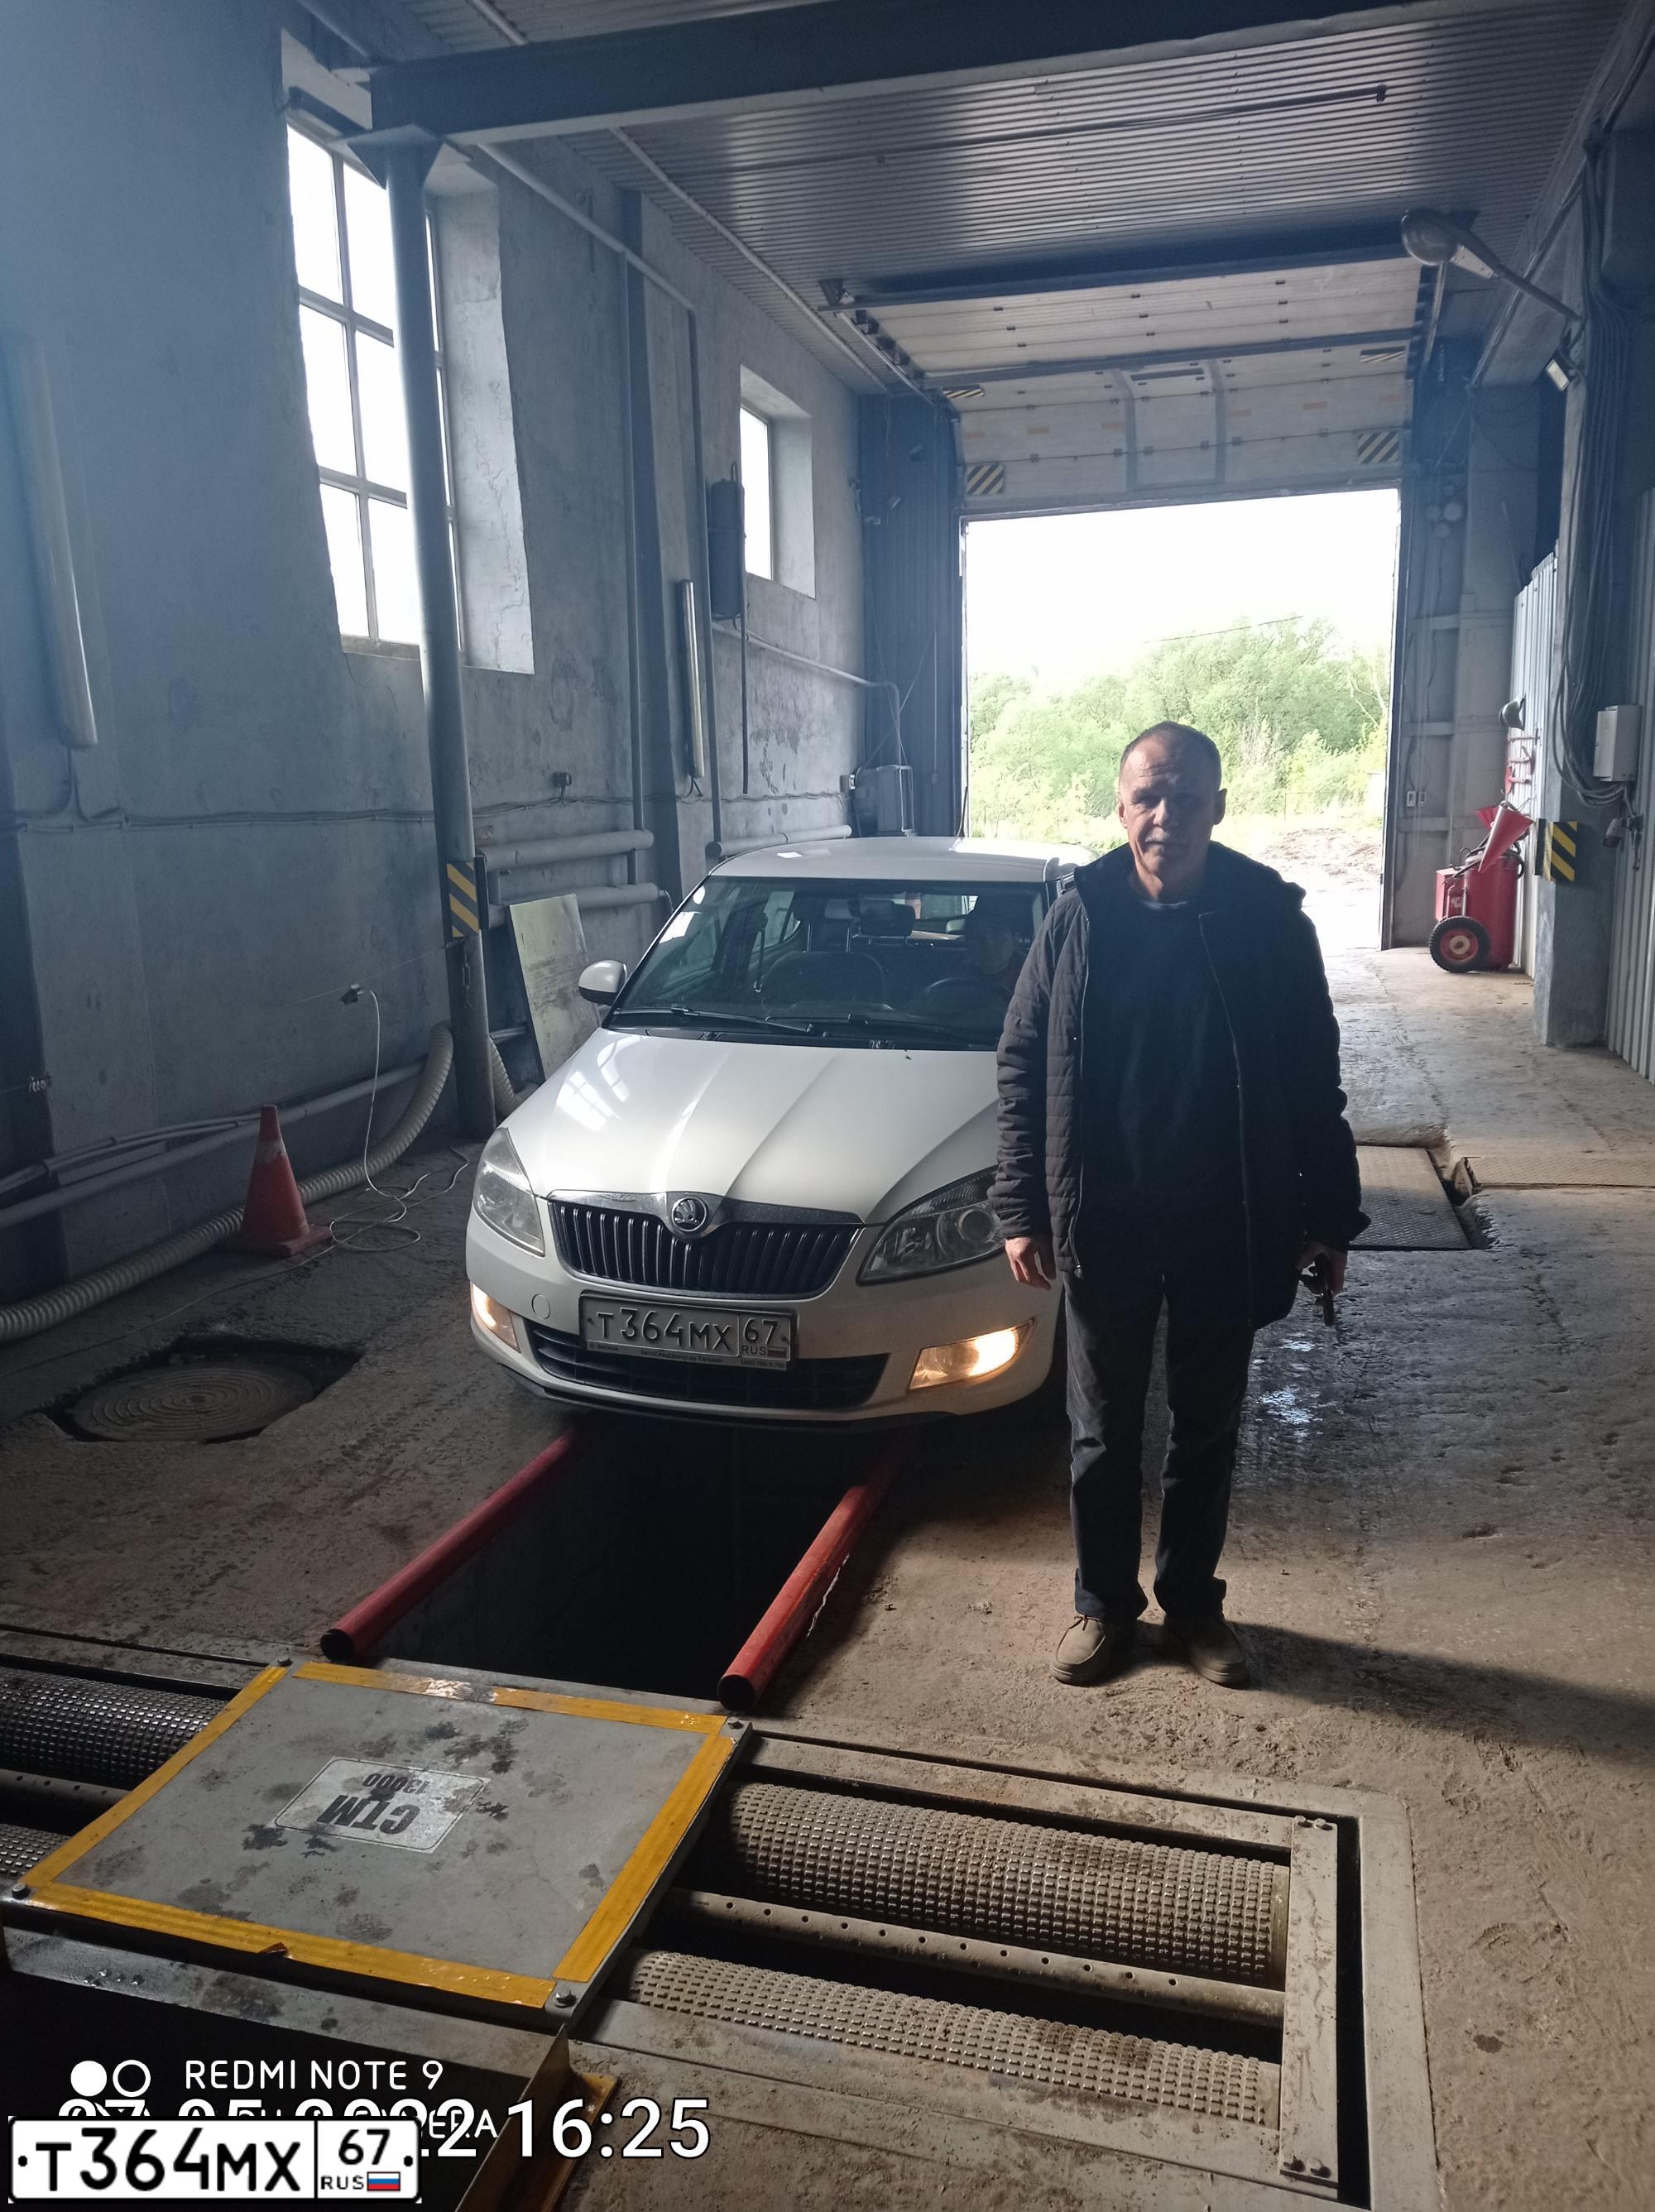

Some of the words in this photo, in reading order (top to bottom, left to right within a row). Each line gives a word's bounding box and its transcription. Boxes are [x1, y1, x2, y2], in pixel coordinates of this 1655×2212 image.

[597, 1308, 732, 1351] Т364МХ
[745, 1317, 779, 1346] 67
[741, 1345, 767, 1356] RUS
[316, 1794, 420, 1835] СТМ
